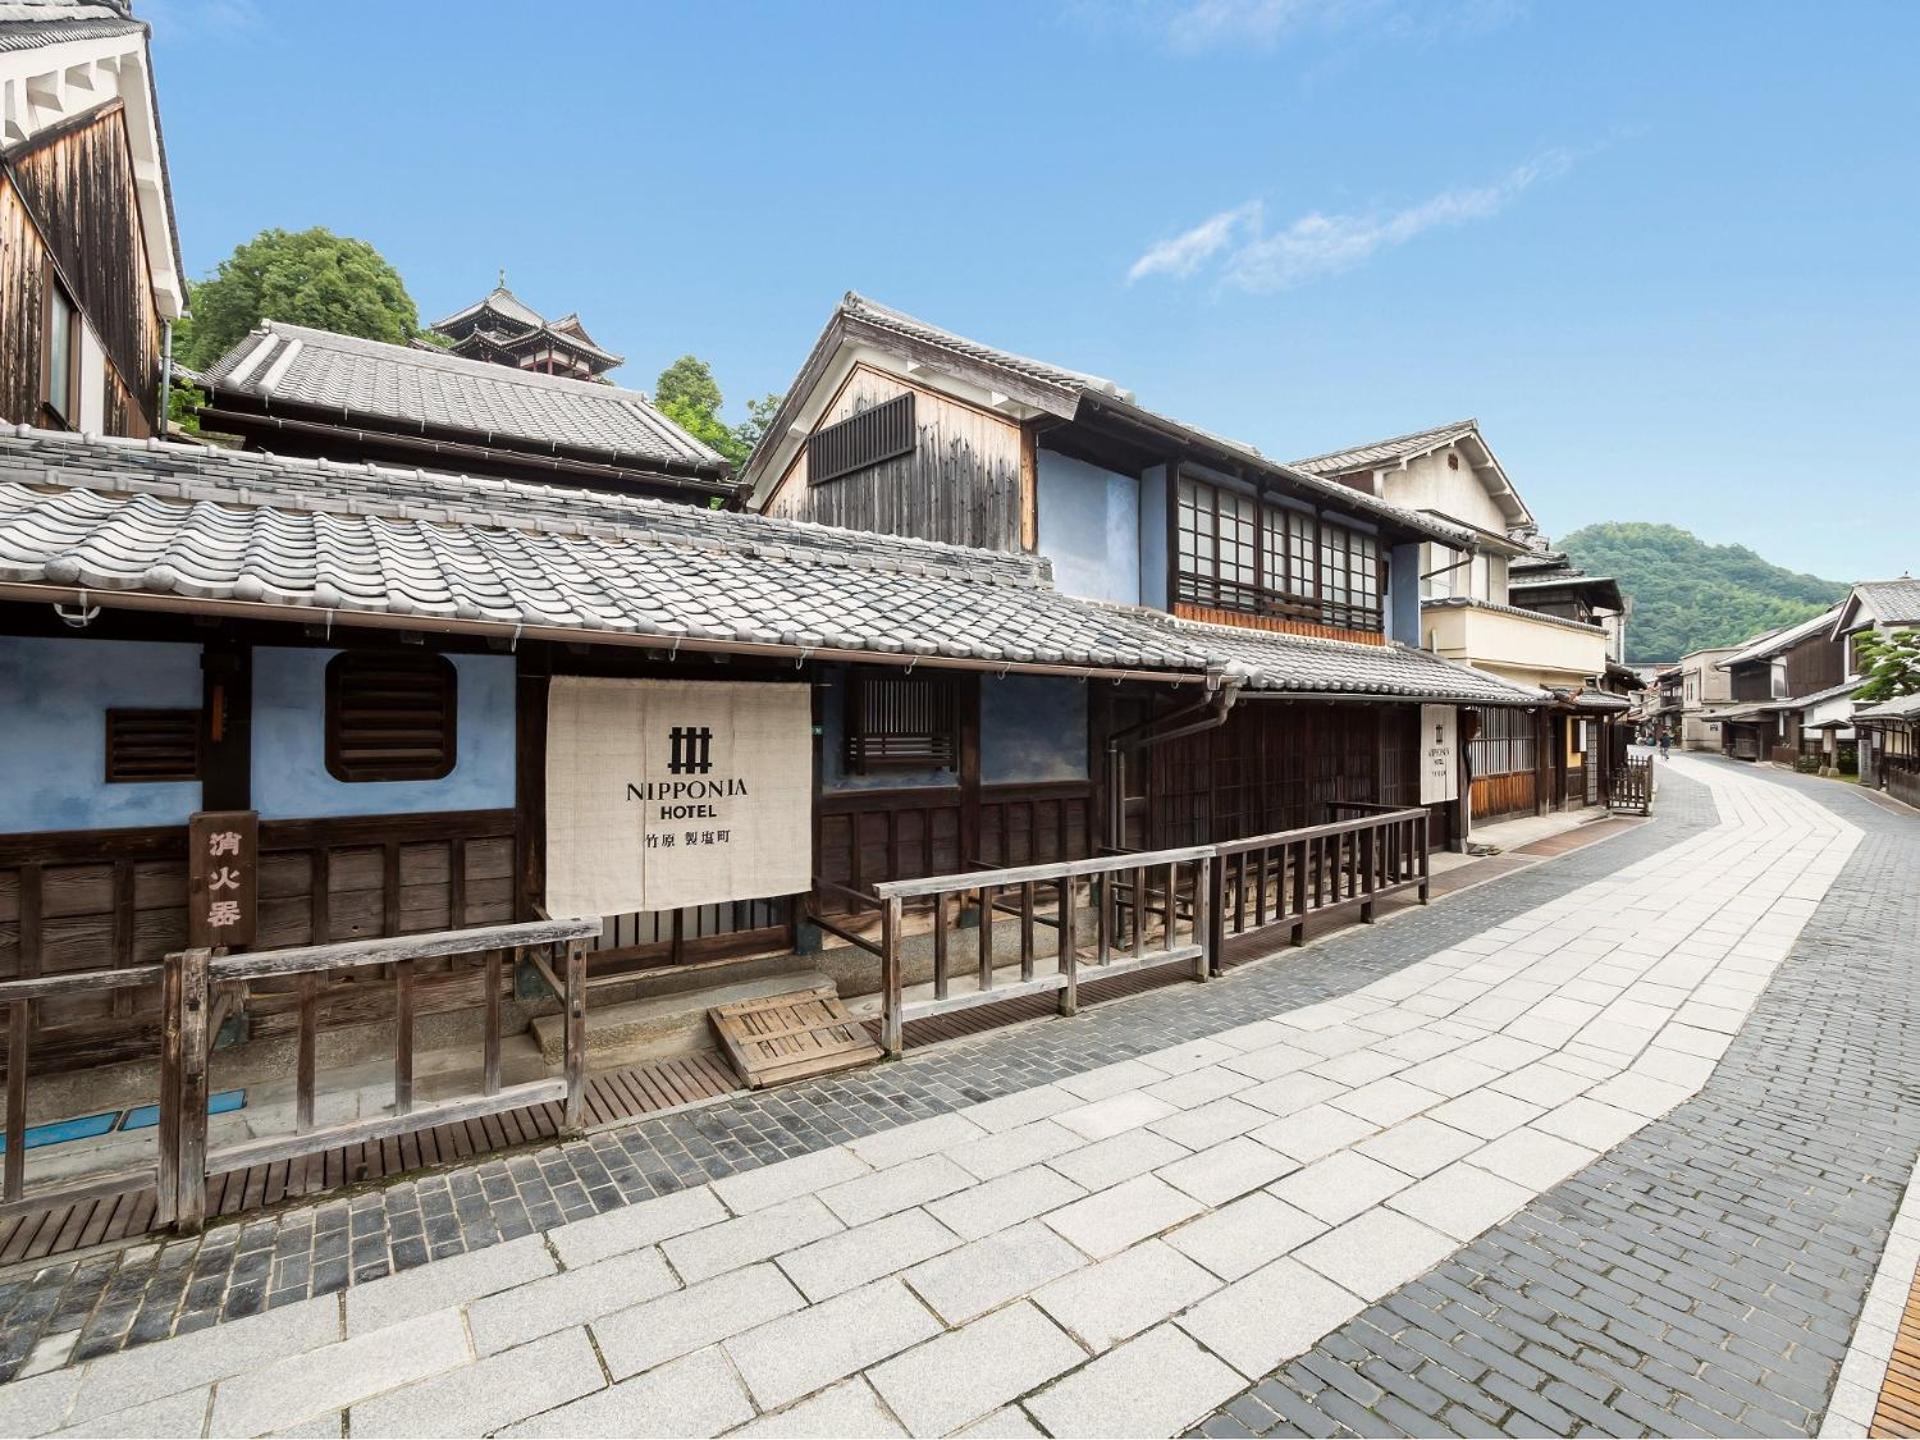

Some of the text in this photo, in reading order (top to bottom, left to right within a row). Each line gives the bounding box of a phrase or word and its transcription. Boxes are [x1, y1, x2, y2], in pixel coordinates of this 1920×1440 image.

[627, 778, 748, 800] NIPPONIA
[661, 804, 717, 819] HOTEL
[646, 830, 730, 848] 竹原 製塩町
[208, 831, 241, 927] 消火器
